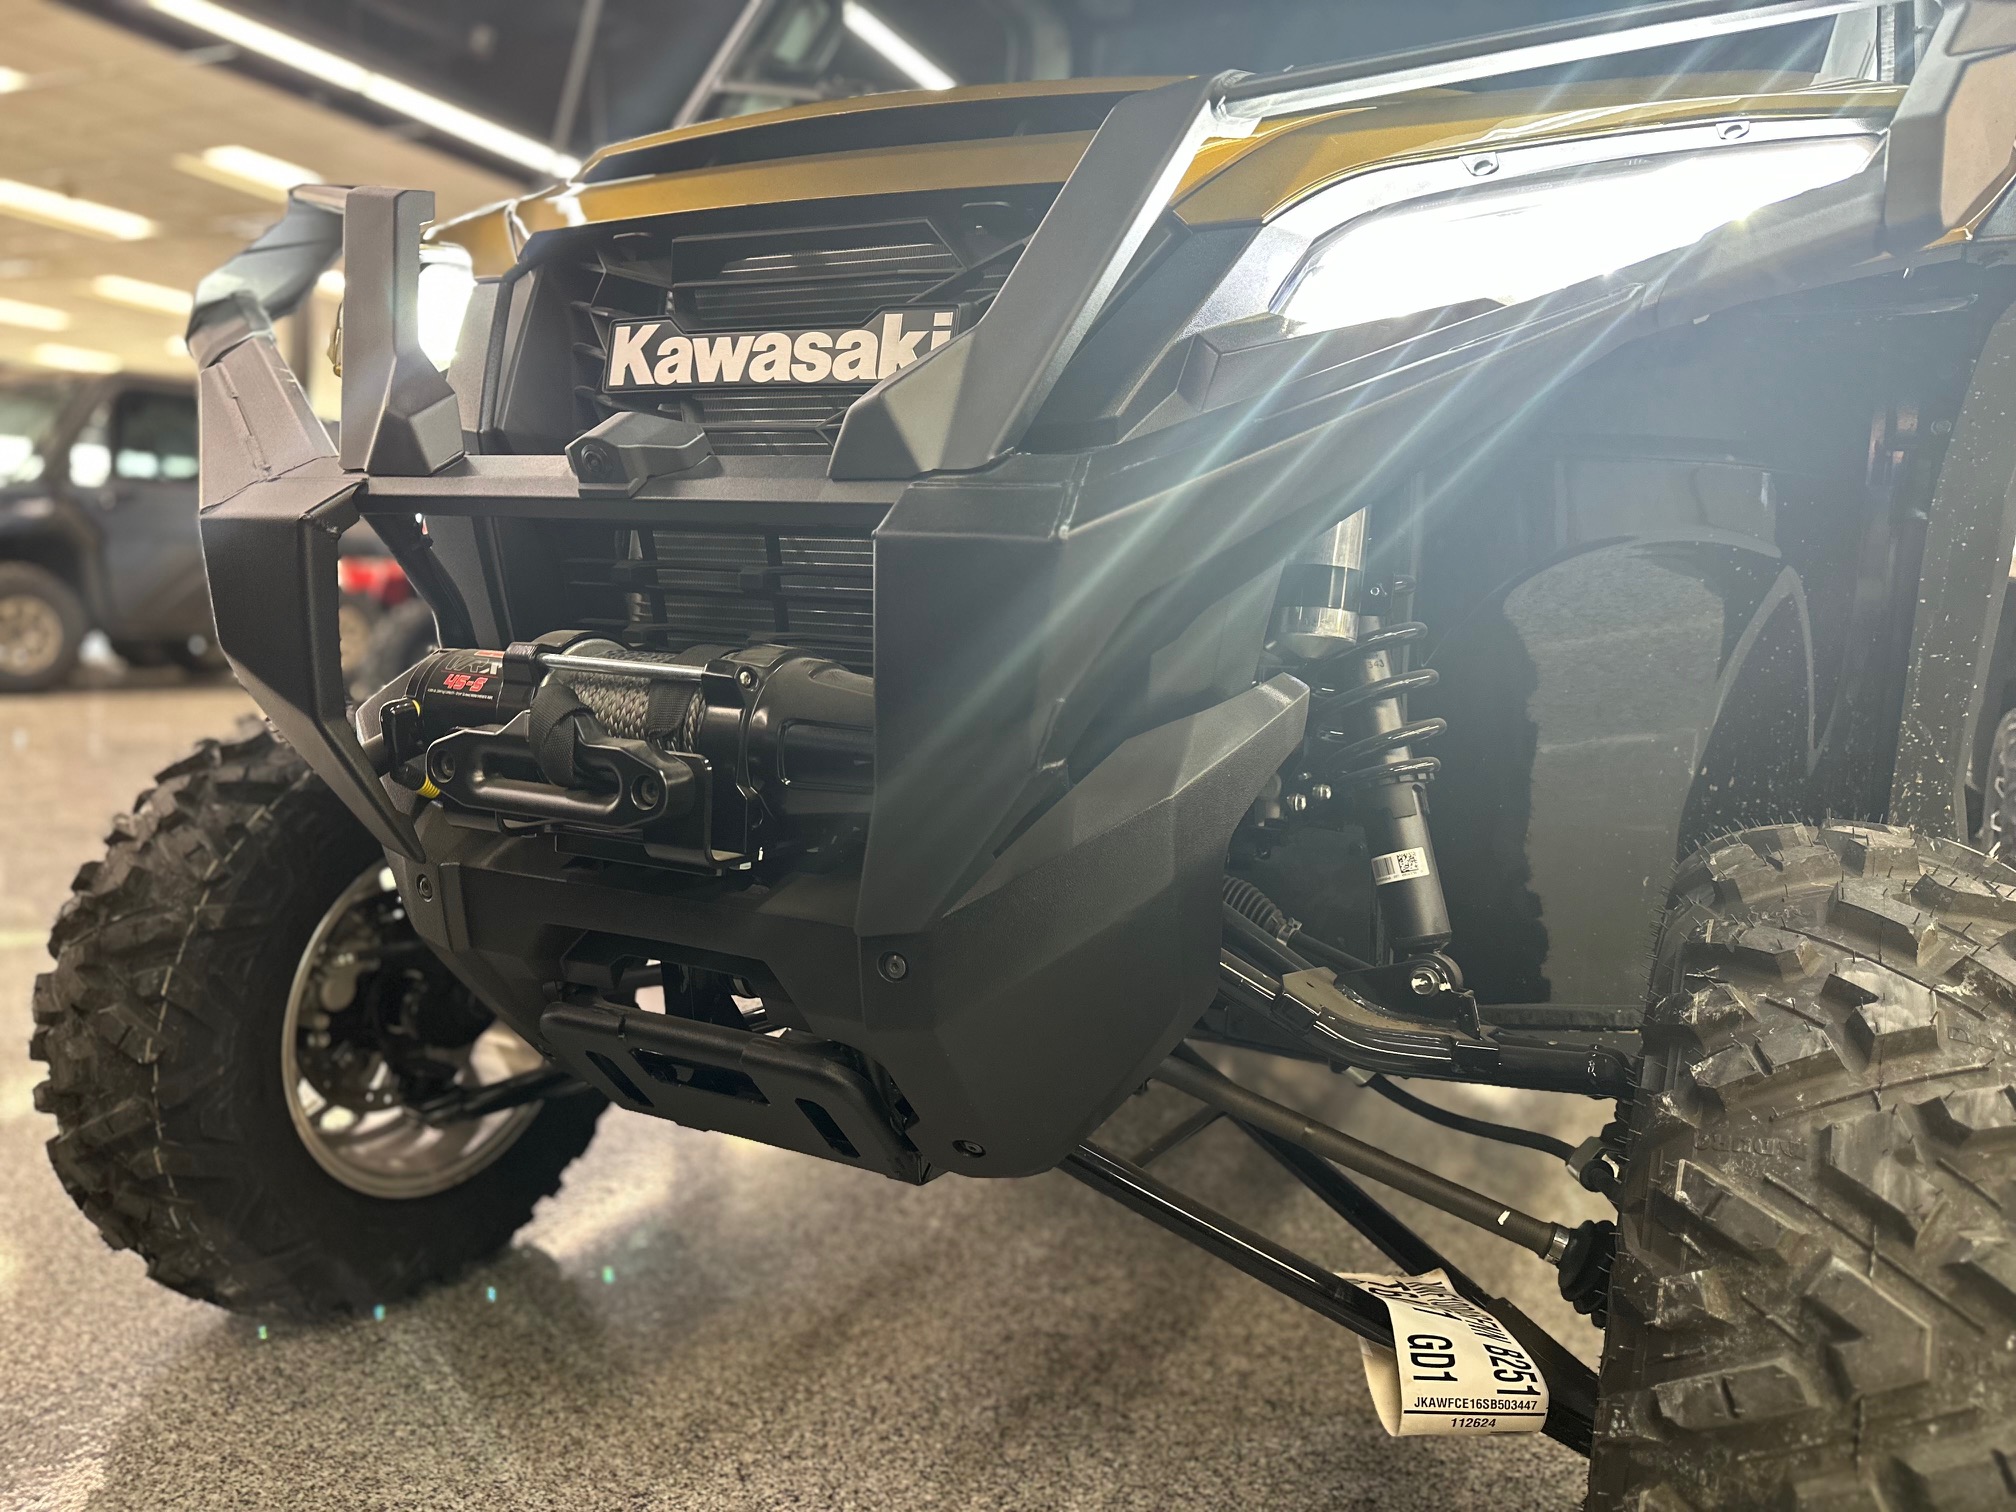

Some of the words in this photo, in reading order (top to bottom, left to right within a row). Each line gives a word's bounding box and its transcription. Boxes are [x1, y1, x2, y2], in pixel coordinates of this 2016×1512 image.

[609, 312, 954, 386] Kawasaki
[1407, 1334, 1458, 1382] GD1
[1483, 1343, 1541, 1396] B251
[1414, 1397, 1538, 1411] JKAWFCE16SB503447
[1451, 1418, 1496, 1428] 112624
